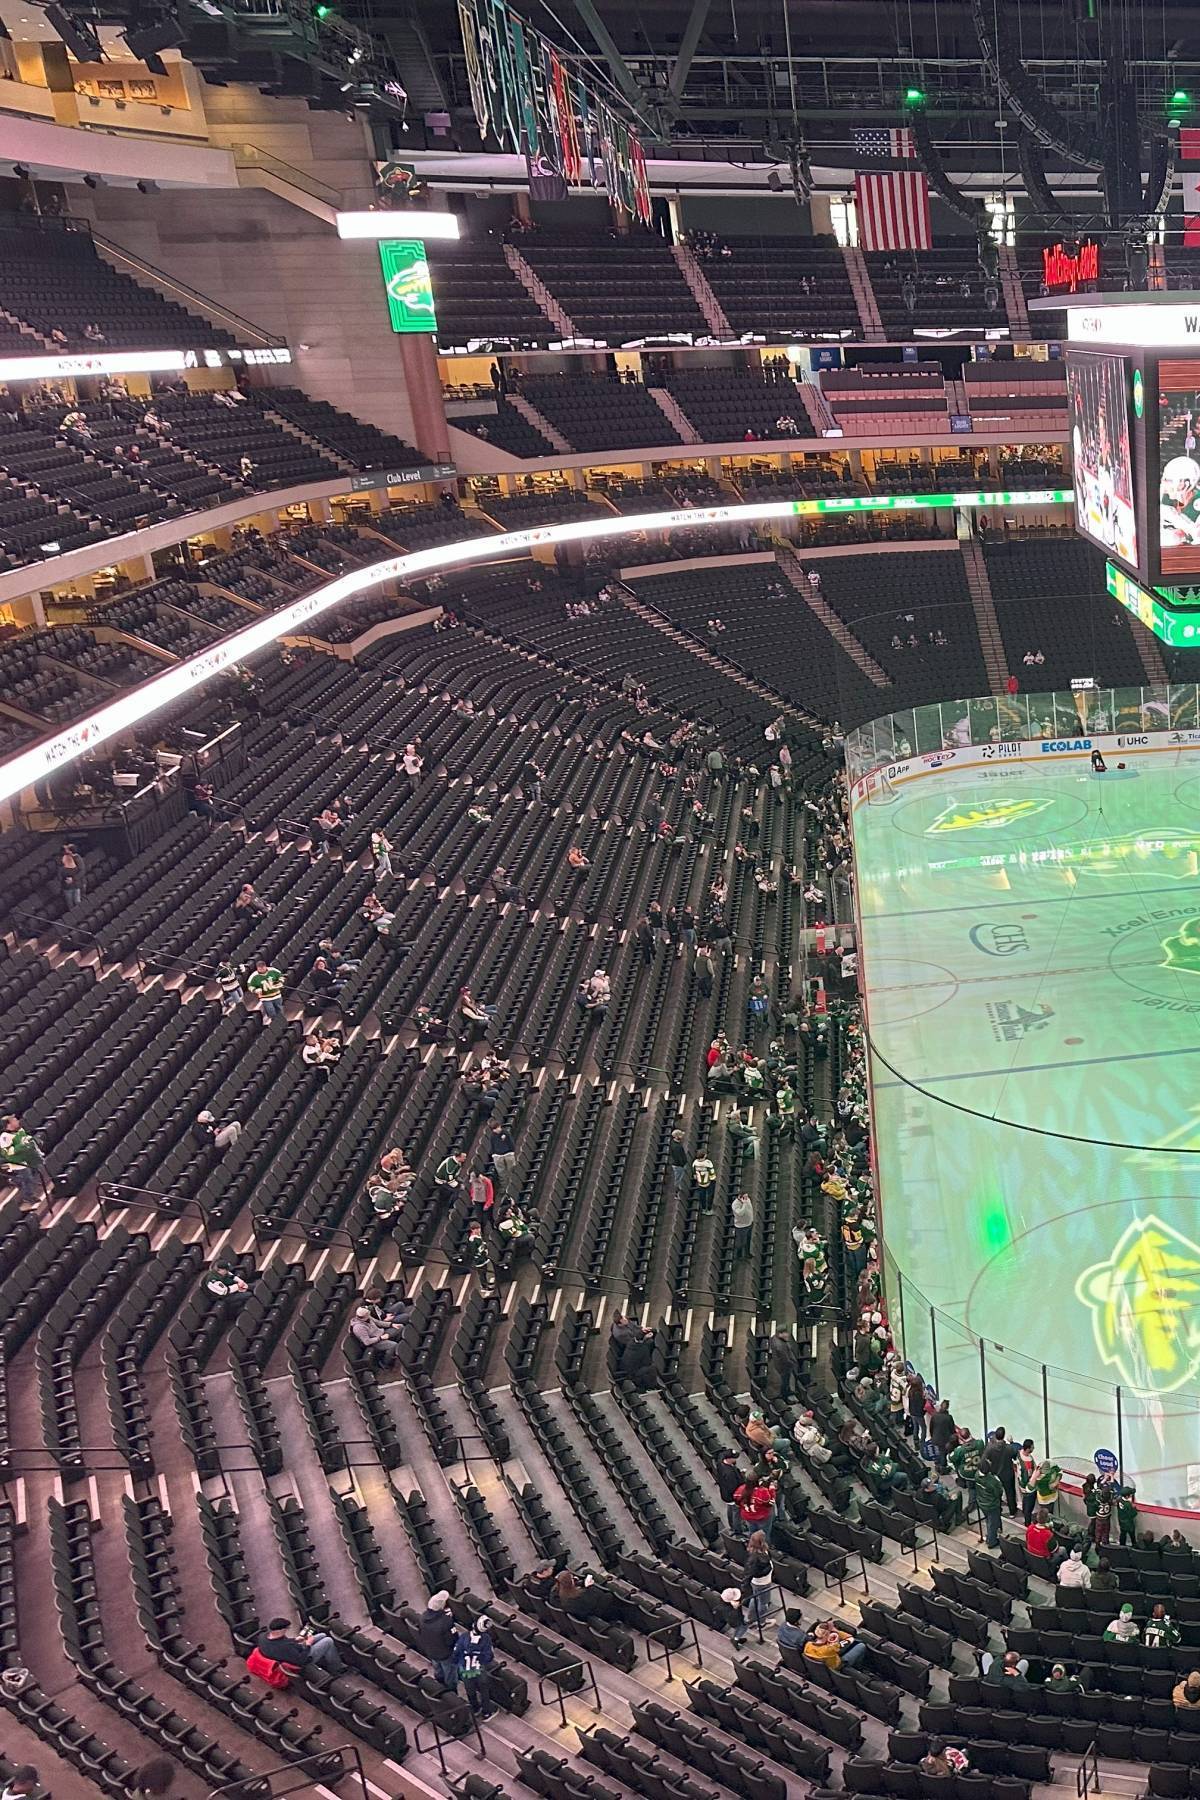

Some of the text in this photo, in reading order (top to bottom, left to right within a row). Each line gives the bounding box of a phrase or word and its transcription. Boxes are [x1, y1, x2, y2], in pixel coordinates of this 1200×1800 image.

[386, 474, 401, 484] Club
[402, 470, 421, 482] Level
[998, 742, 1022, 754] PILOT
[1041, 739, 1092, 753] ECOLAB
[1126, 736, 1149, 747] UHC
[1100, 915, 1149, 937] Xcel
[991, 924, 1030, 952] CHS
[1097, 1453, 1114, 1461] Cheer
[463, 1655, 481, 1670] 14
